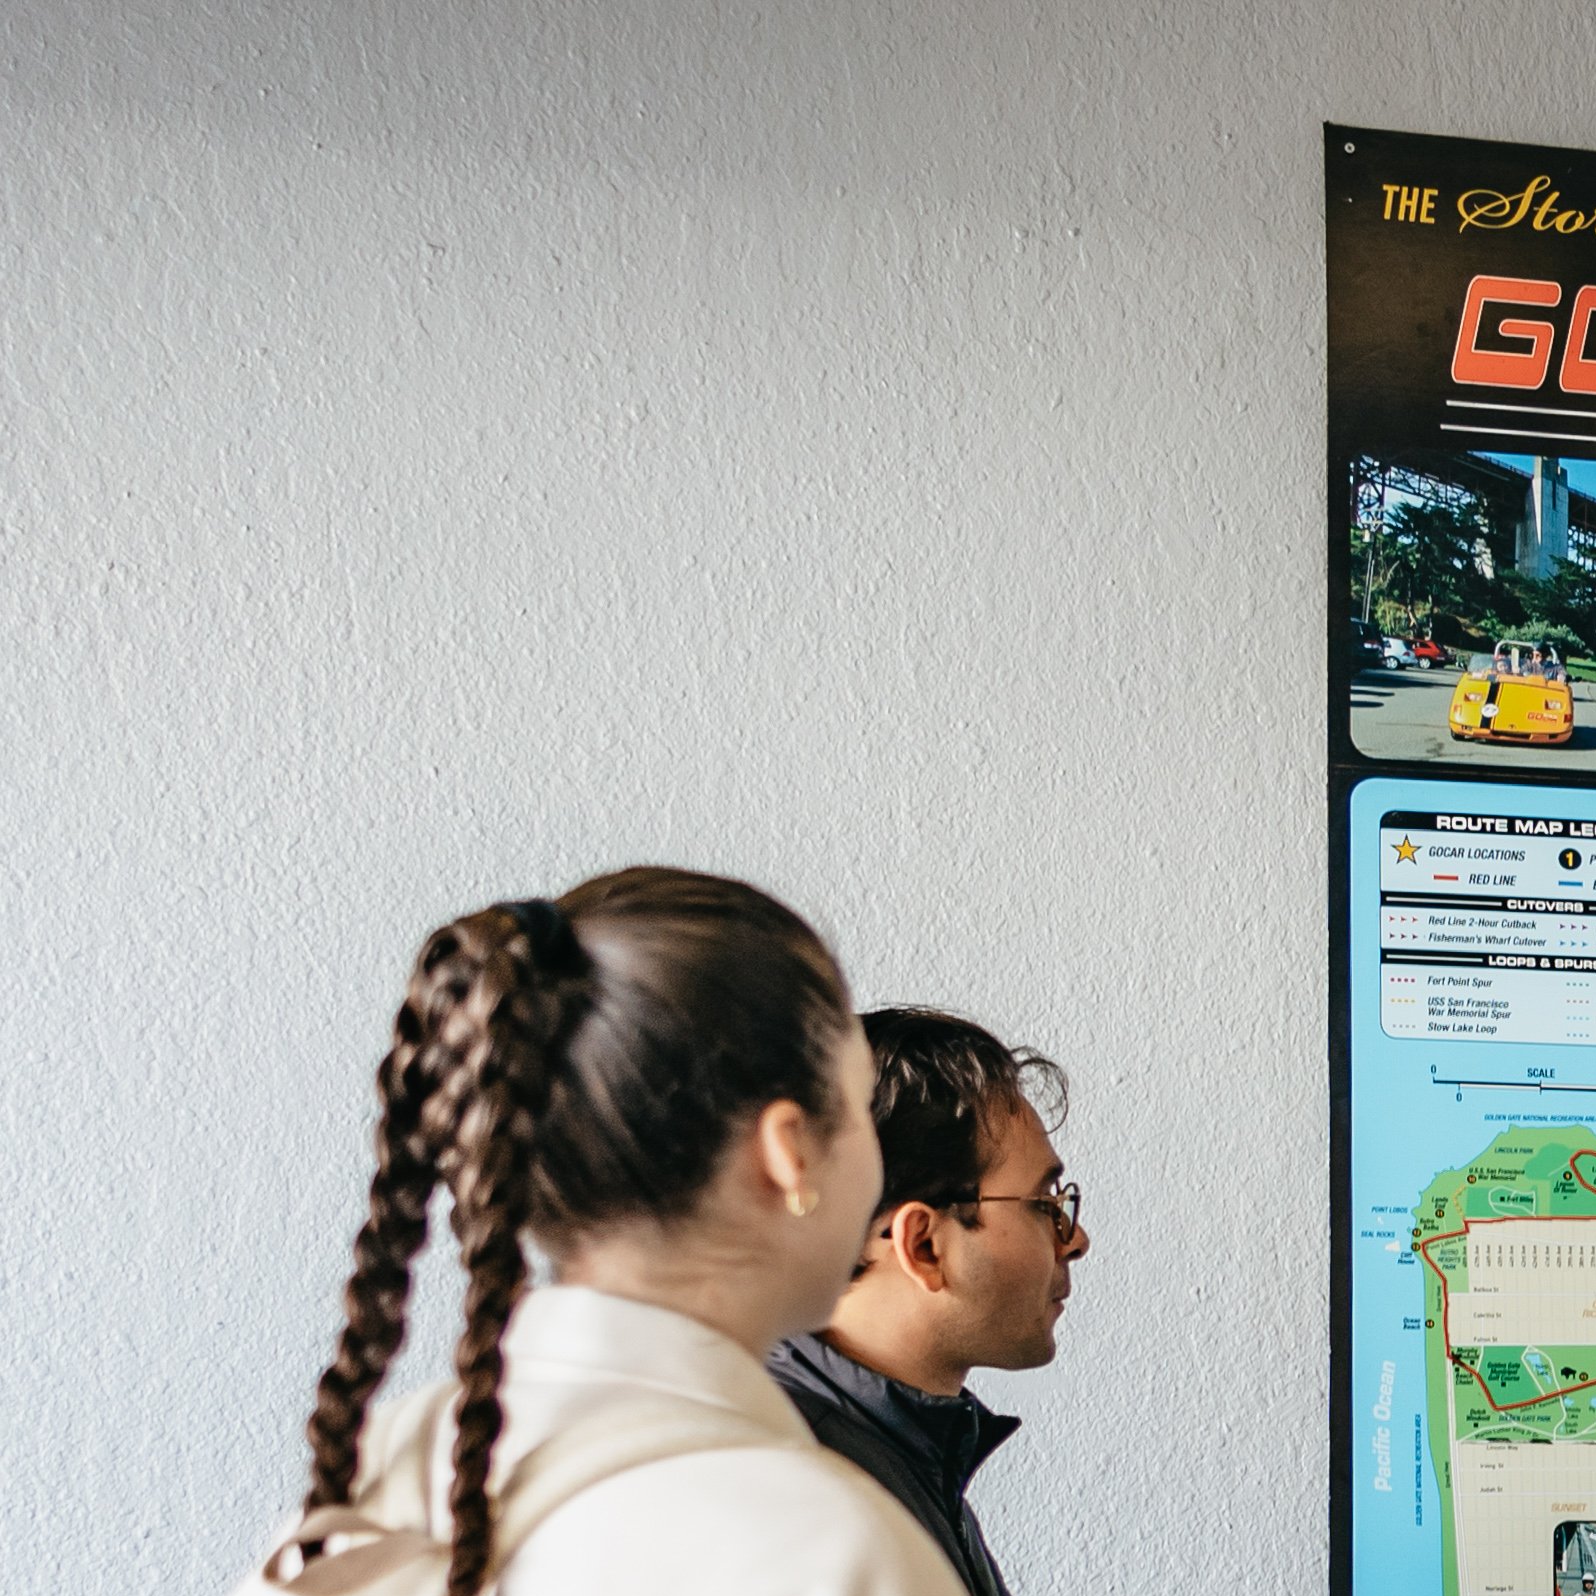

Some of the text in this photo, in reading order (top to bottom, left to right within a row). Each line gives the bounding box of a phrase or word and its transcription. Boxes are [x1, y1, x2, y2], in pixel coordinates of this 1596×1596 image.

[1382, 184, 1439, 225] THE
[1436, 815, 1508, 833] ROUTE
[1514, 820, 1564, 835] MAP
[1428, 845, 1525, 861] GOCAR LOCATIONS
